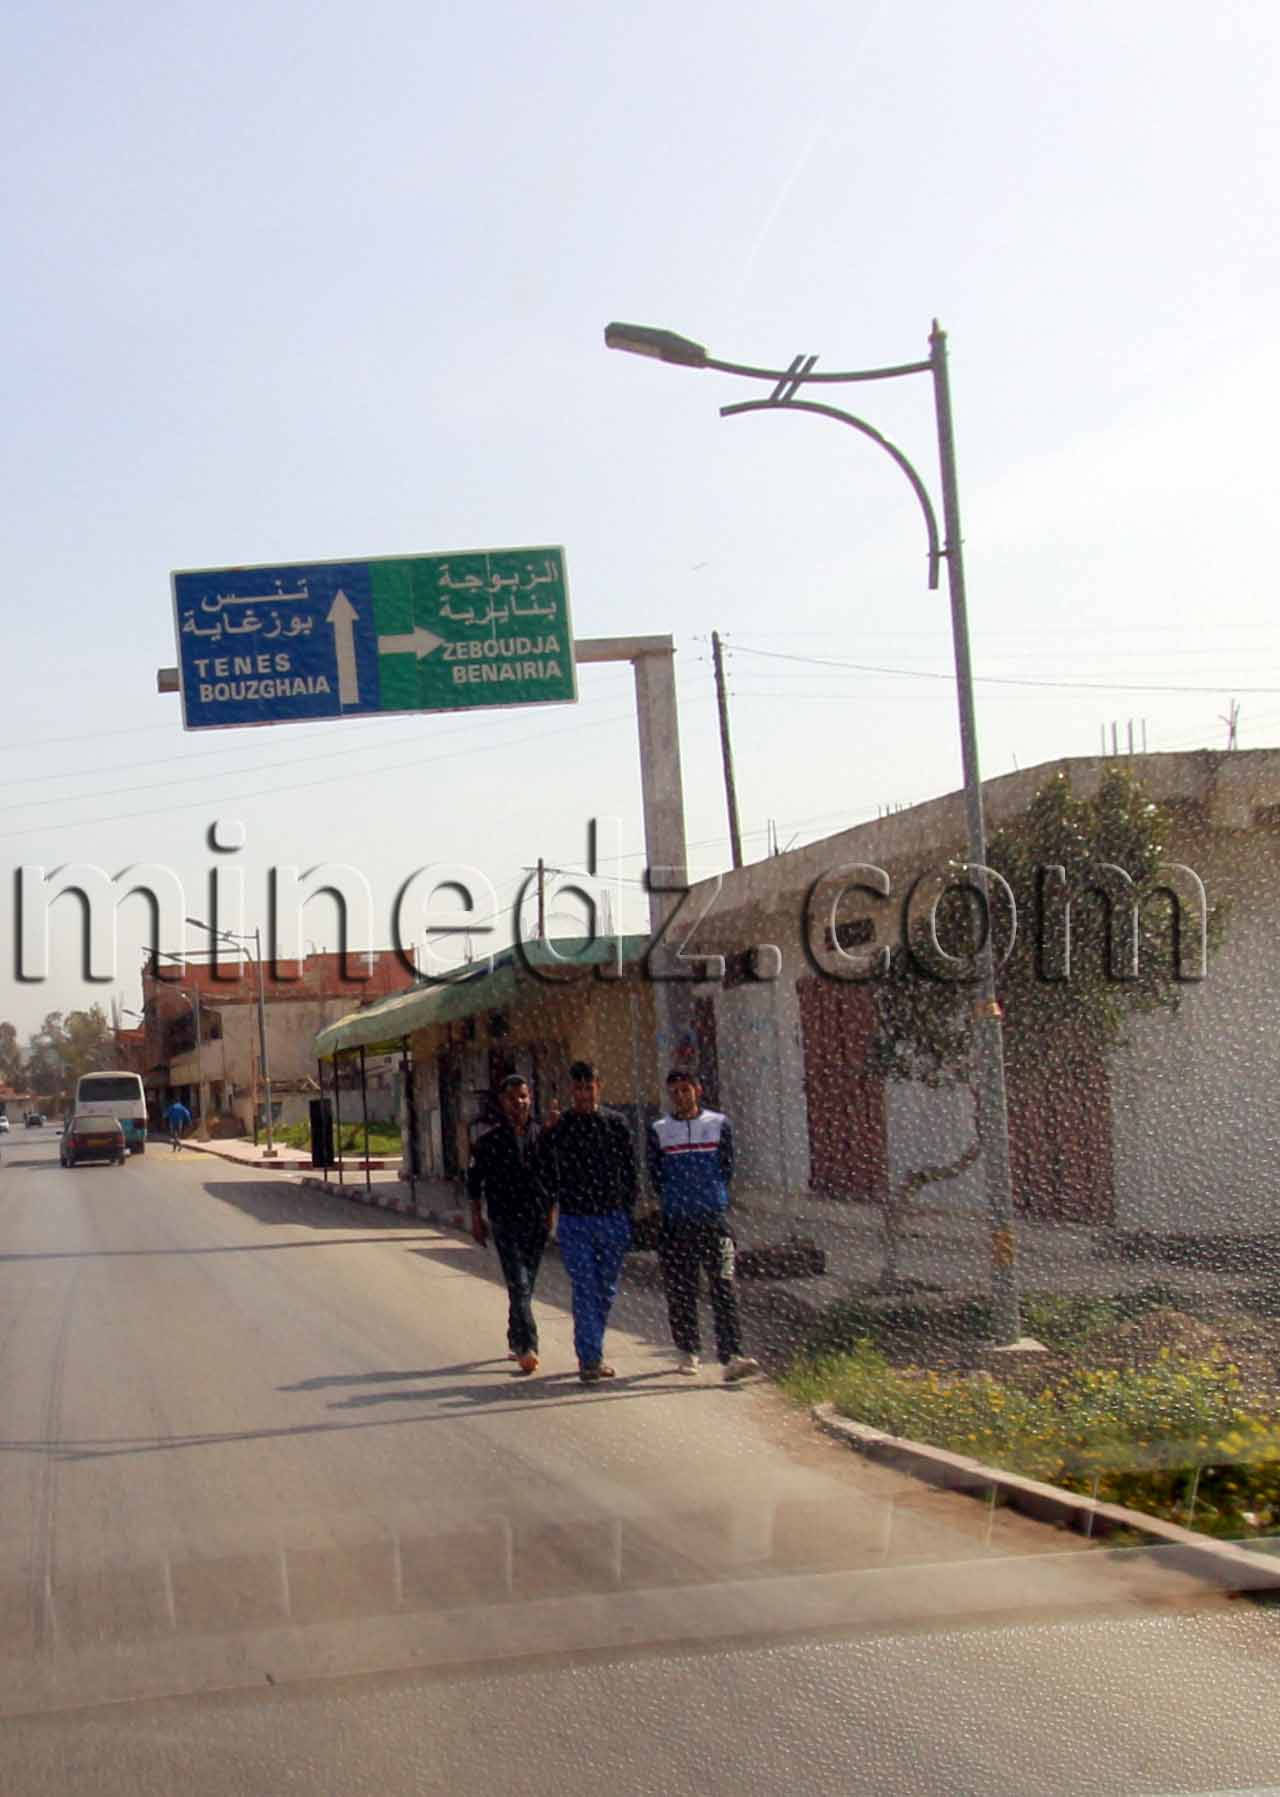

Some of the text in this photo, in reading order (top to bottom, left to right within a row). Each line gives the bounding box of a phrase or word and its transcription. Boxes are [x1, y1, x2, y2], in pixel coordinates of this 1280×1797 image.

[439, 560, 559, 592] الزبوجة
[201, 578, 309, 612] تنس
[182, 609, 313, 641] بوزغاية
[442, 635, 560, 661] ZEBOUDJA
[193, 653, 291, 678] TENES
[453, 660, 561, 684] BENAIRIA
[200, 676, 330, 703] BOUZGHAIA
